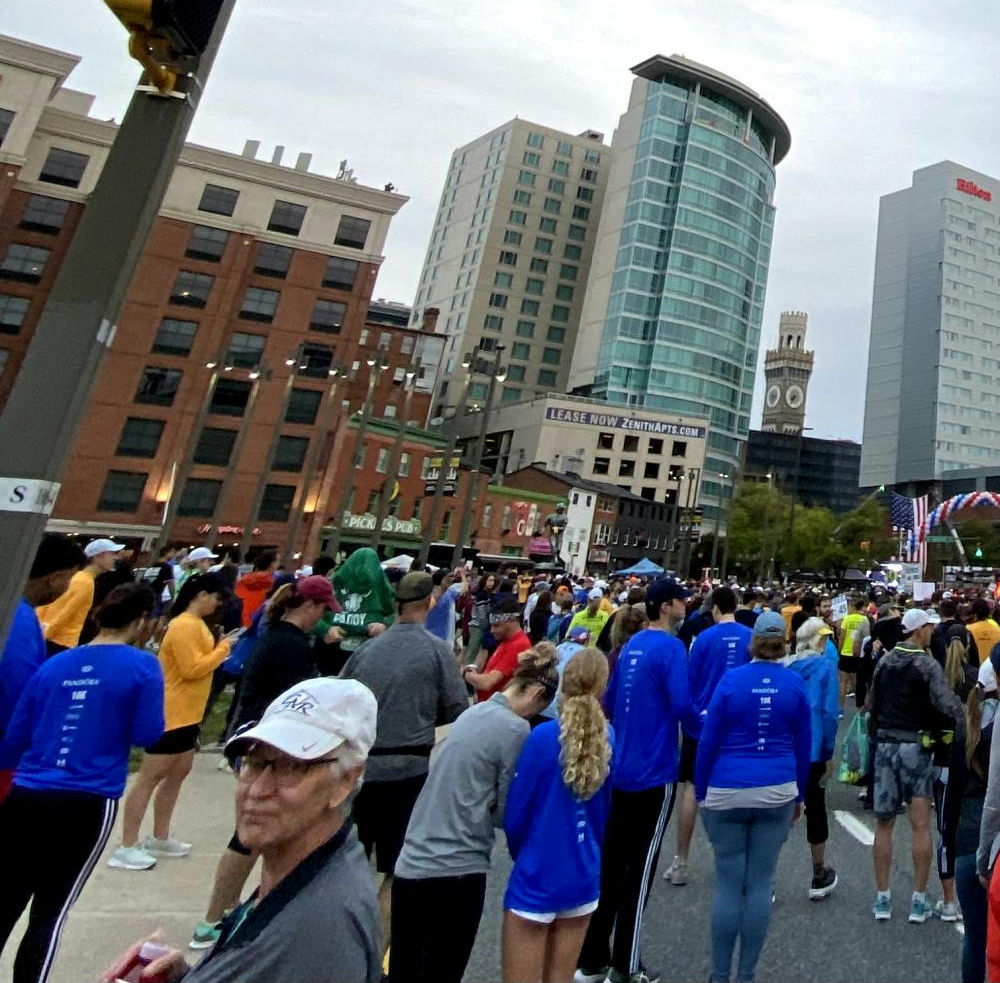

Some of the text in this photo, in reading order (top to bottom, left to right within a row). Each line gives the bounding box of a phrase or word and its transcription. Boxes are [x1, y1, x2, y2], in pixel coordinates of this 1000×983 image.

[551, 408, 587, 424] LEASE
[590, 413, 618, 428] NOW
[10, 485, 27, 504] S
[394, 521, 414, 533] PUB
